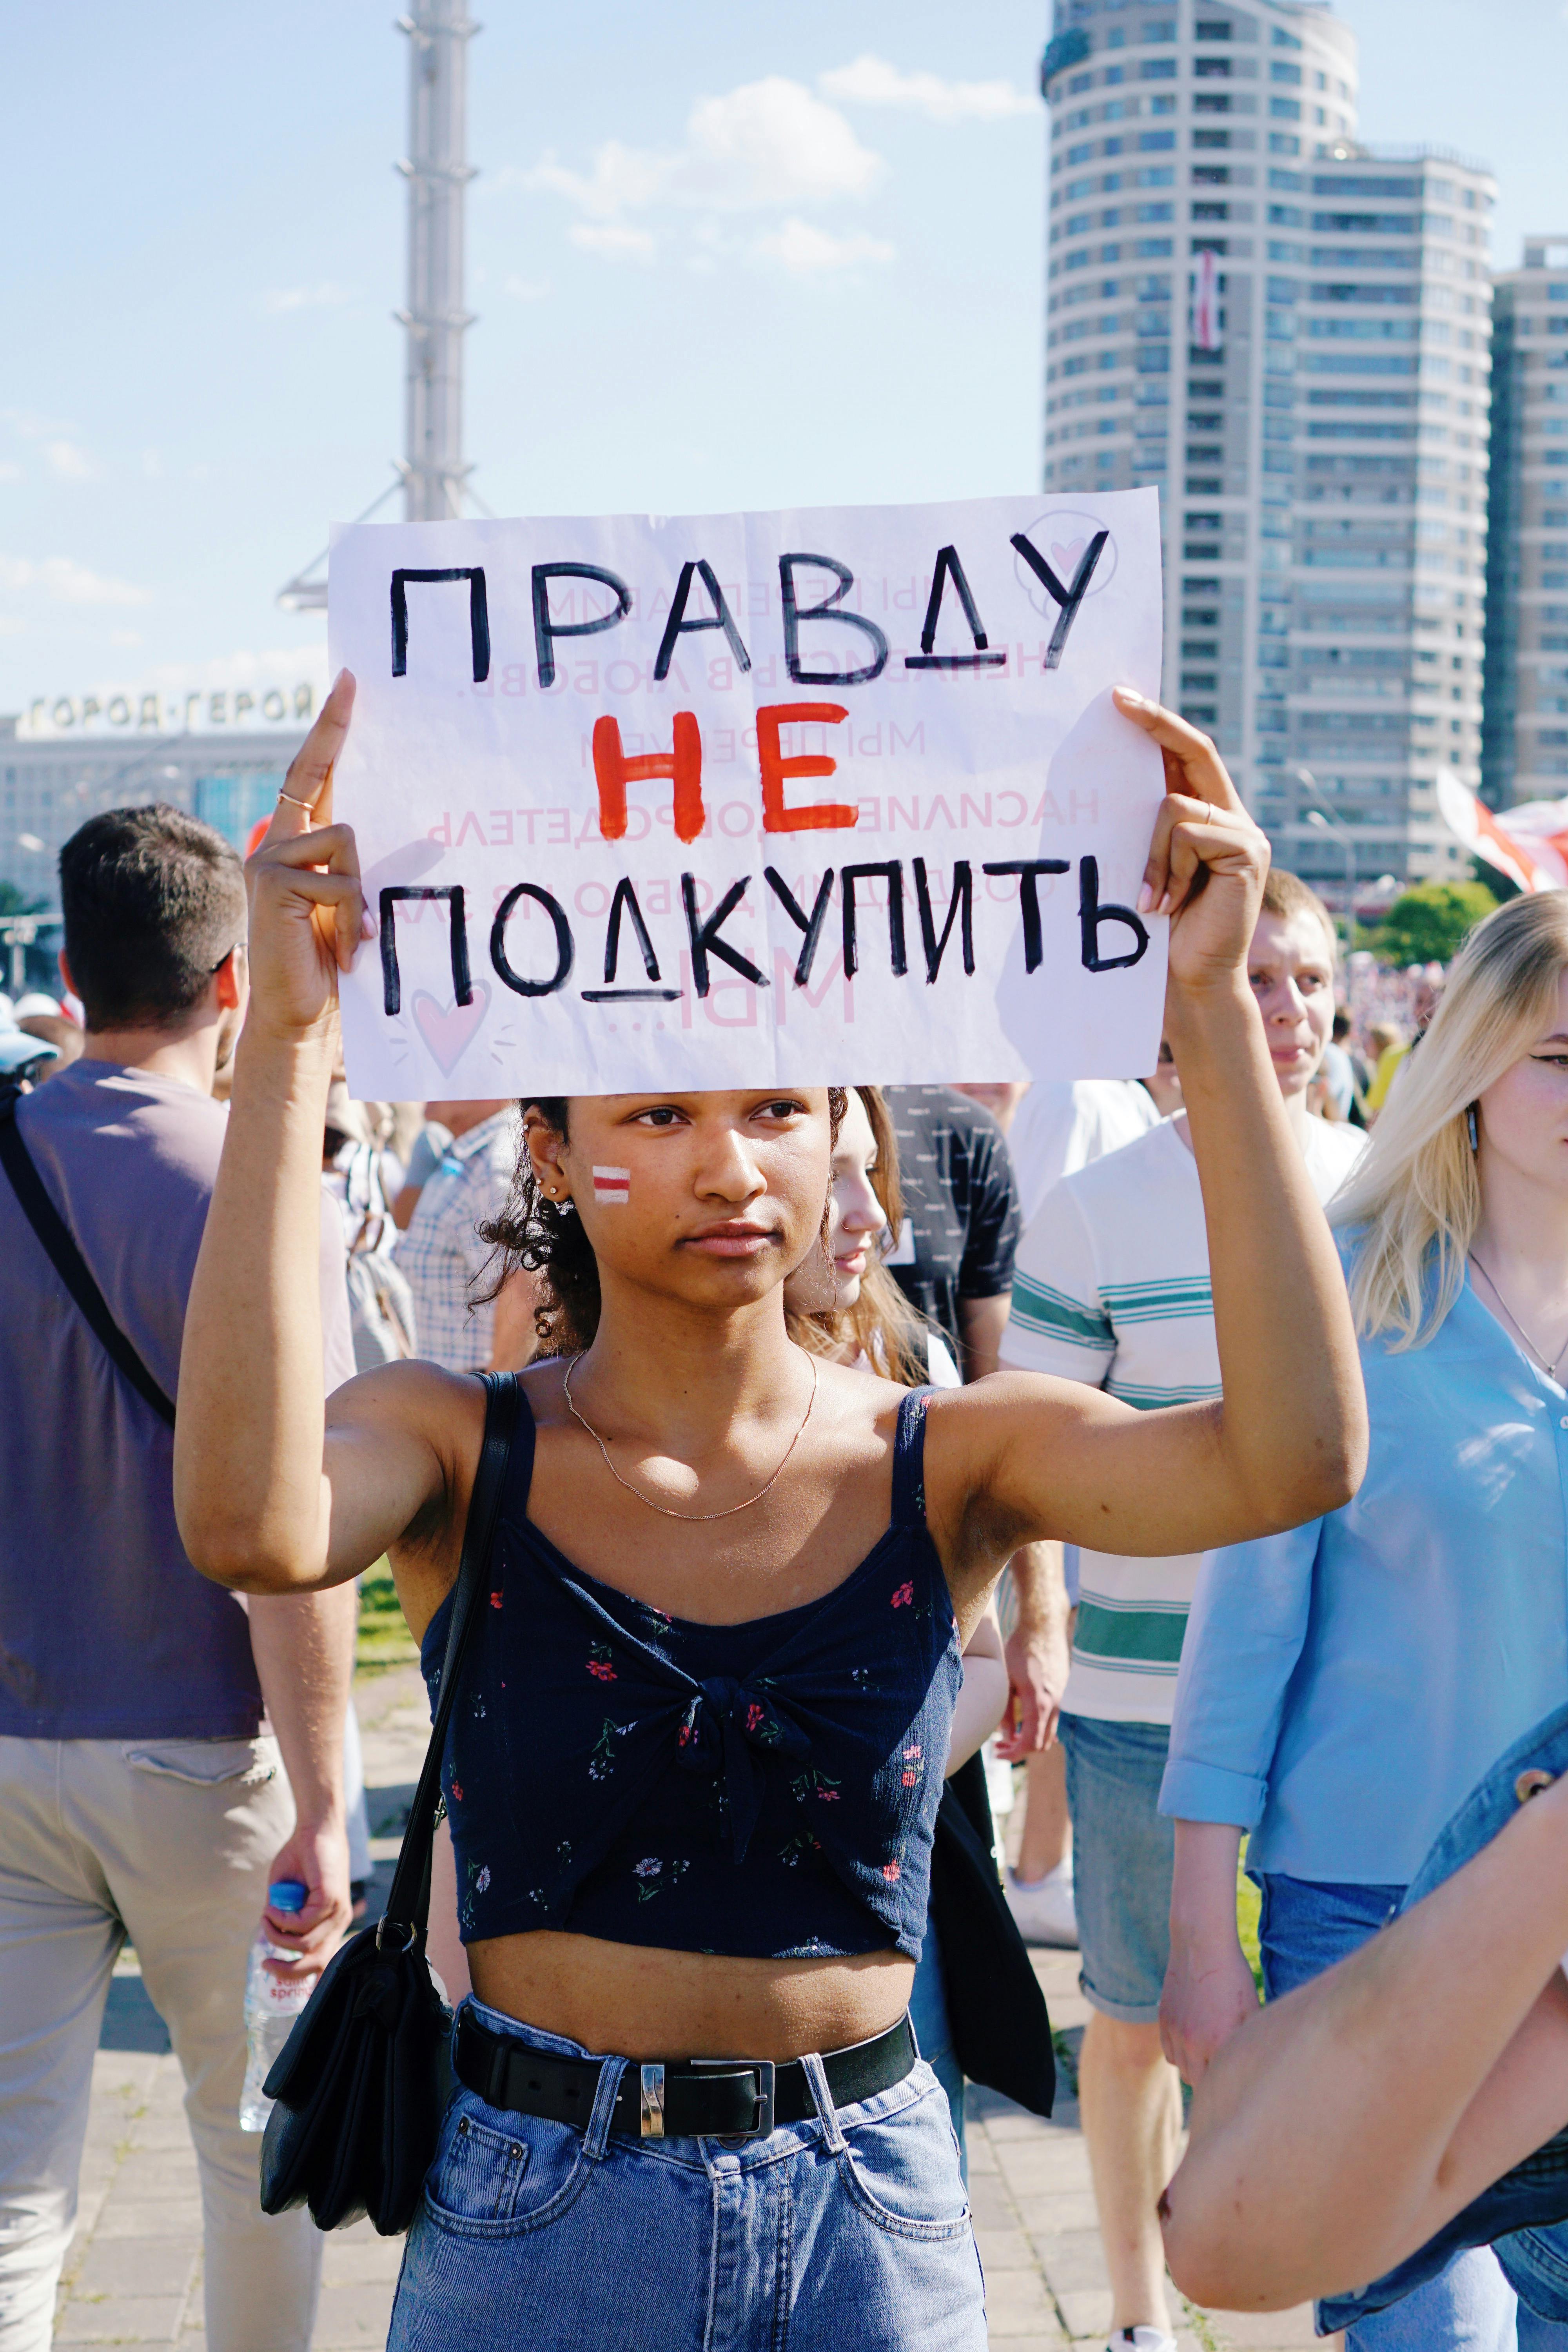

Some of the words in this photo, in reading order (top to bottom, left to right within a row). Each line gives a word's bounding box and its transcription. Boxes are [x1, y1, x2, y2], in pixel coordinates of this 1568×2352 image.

[391, 530, 1109, 687] ПРАВДУ
[592, 702, 858, 844] НЕ
[379, 855, 1150, 1016] ПОДКУПИТЬ
